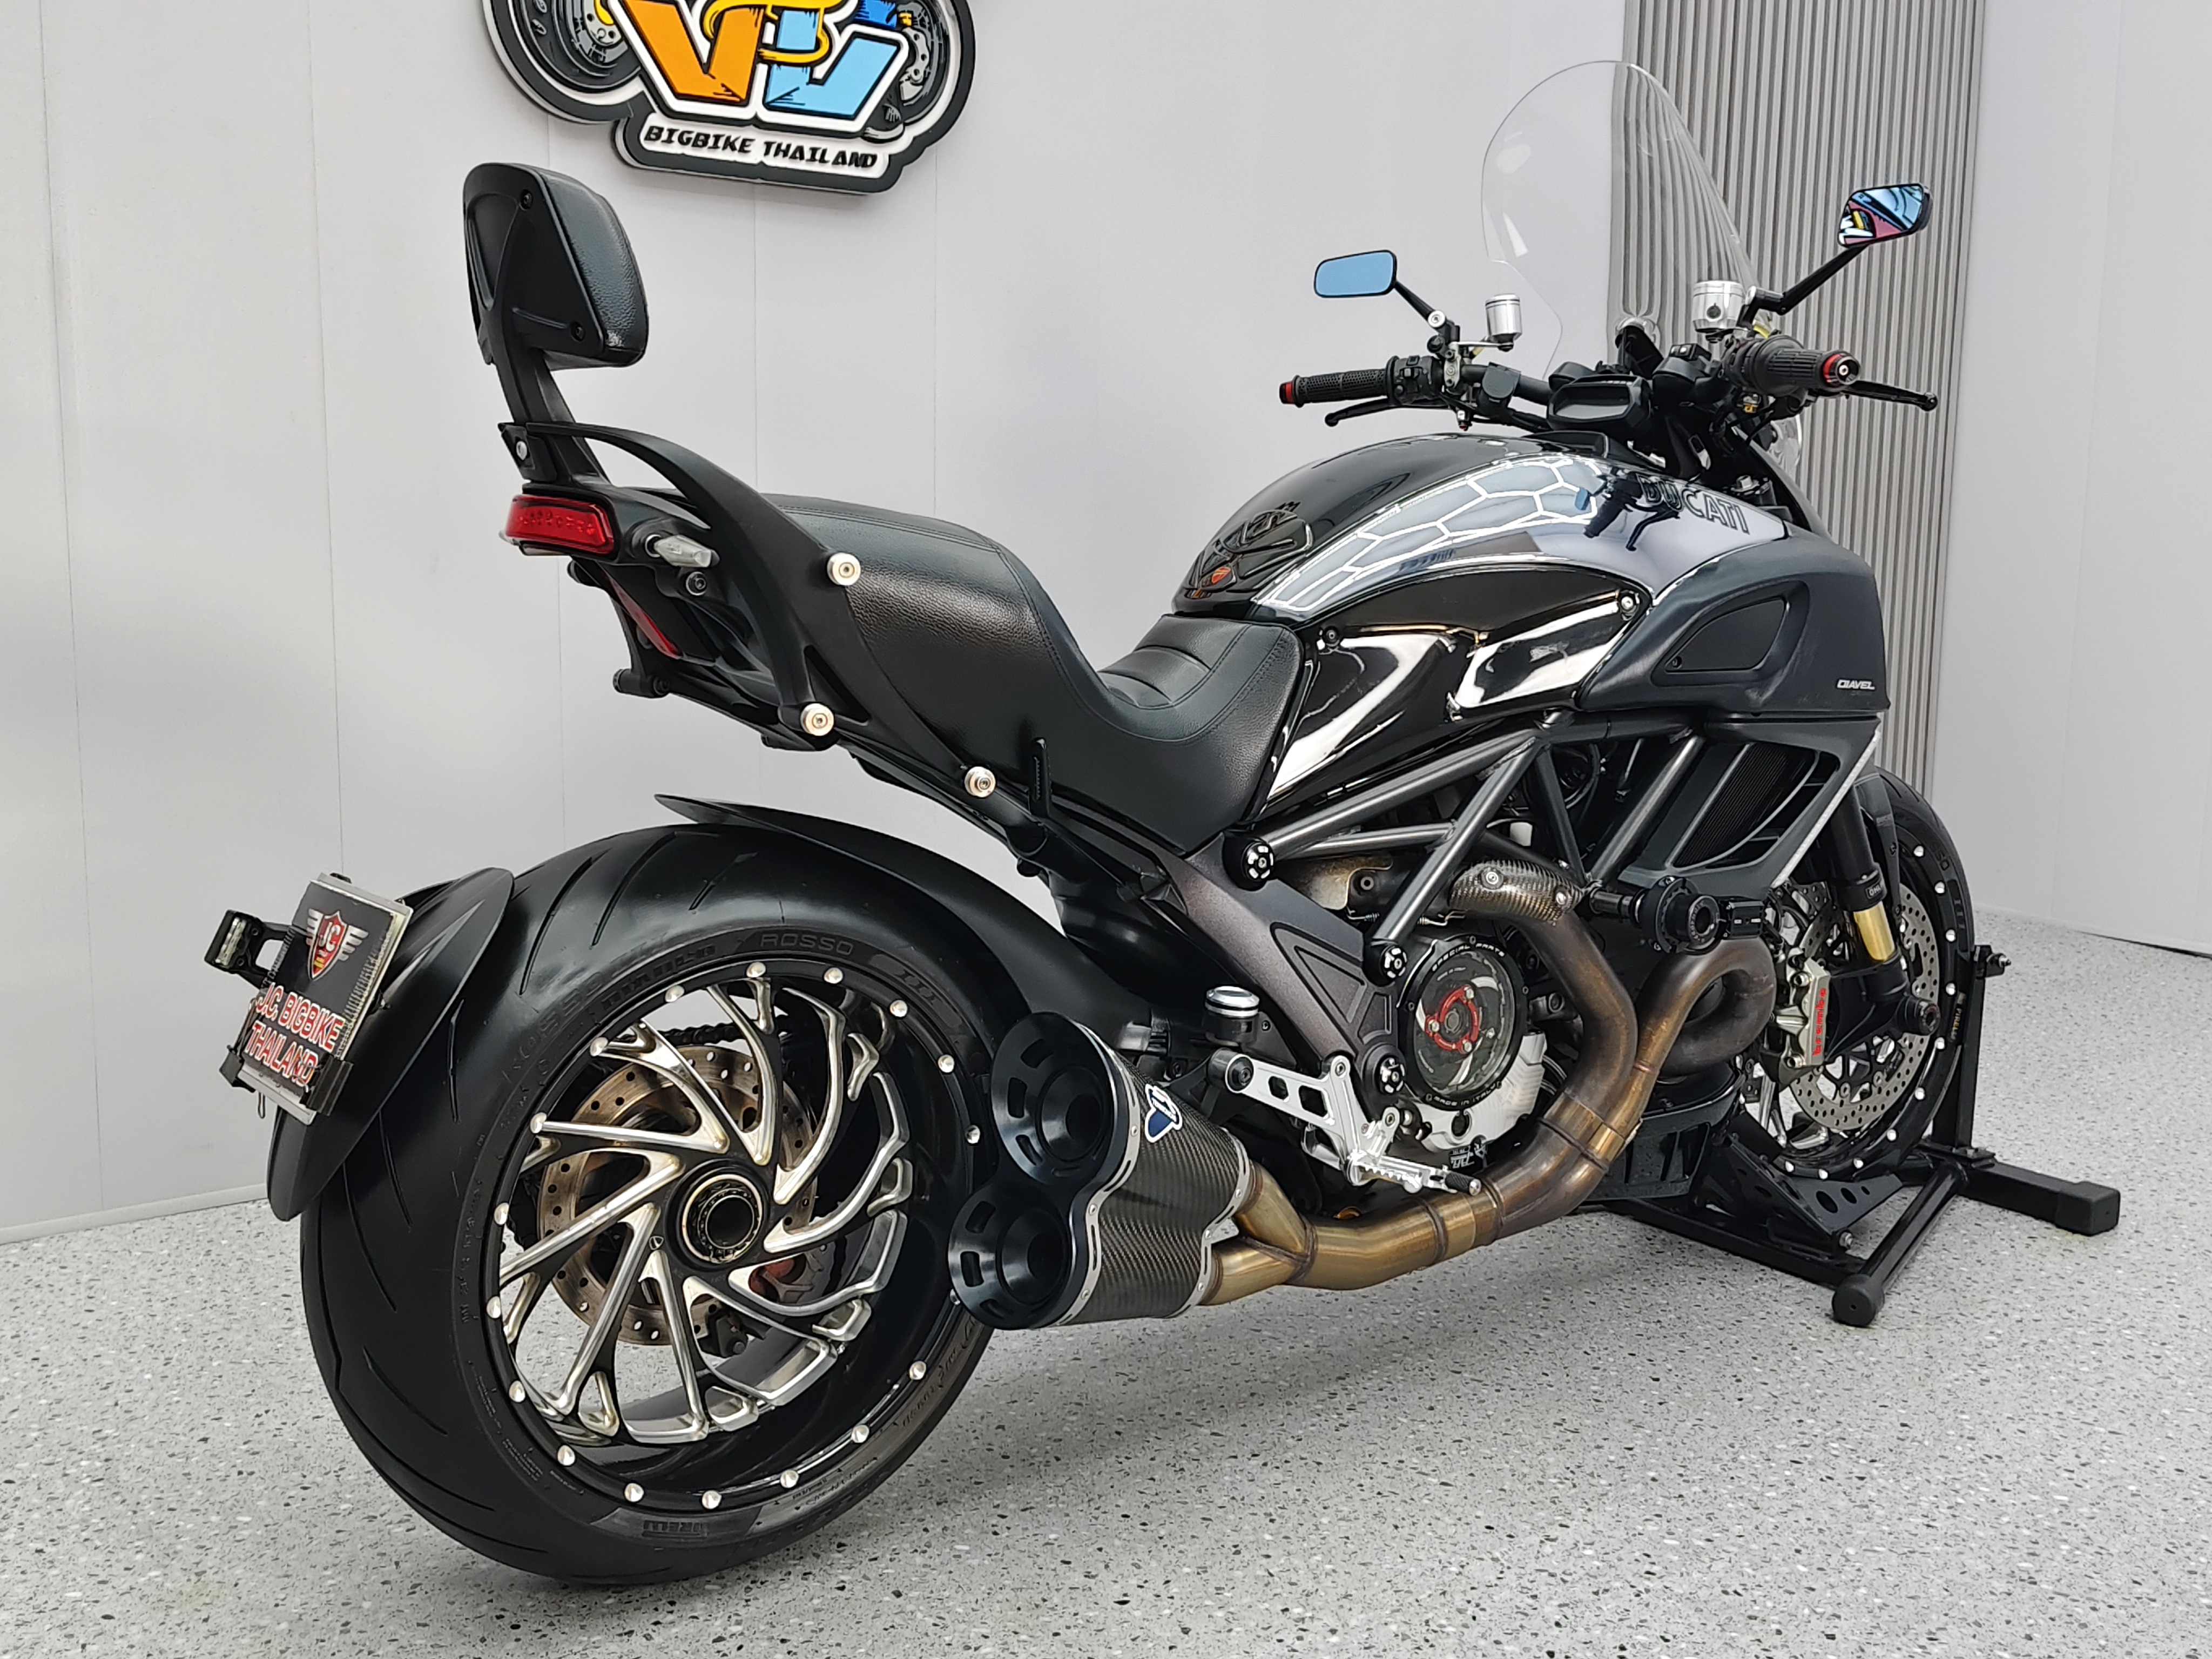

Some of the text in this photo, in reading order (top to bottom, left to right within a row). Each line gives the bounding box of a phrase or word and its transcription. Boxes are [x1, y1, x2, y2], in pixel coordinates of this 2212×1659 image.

[644, 125, 878, 168] BIGBIKE THAILAND
[1635, 473, 1750, 535] DUCATI
[1837, 679, 1876, 690] DIAVEL
[760, 932, 854, 956] ROSSO
[1432, 945, 1471, 972] SPECIAL
[278, 991, 346, 1054] BIGBIKE
[1812, 988, 1827, 1056] brembo
[244, 1019, 319, 1087] THAILAND
